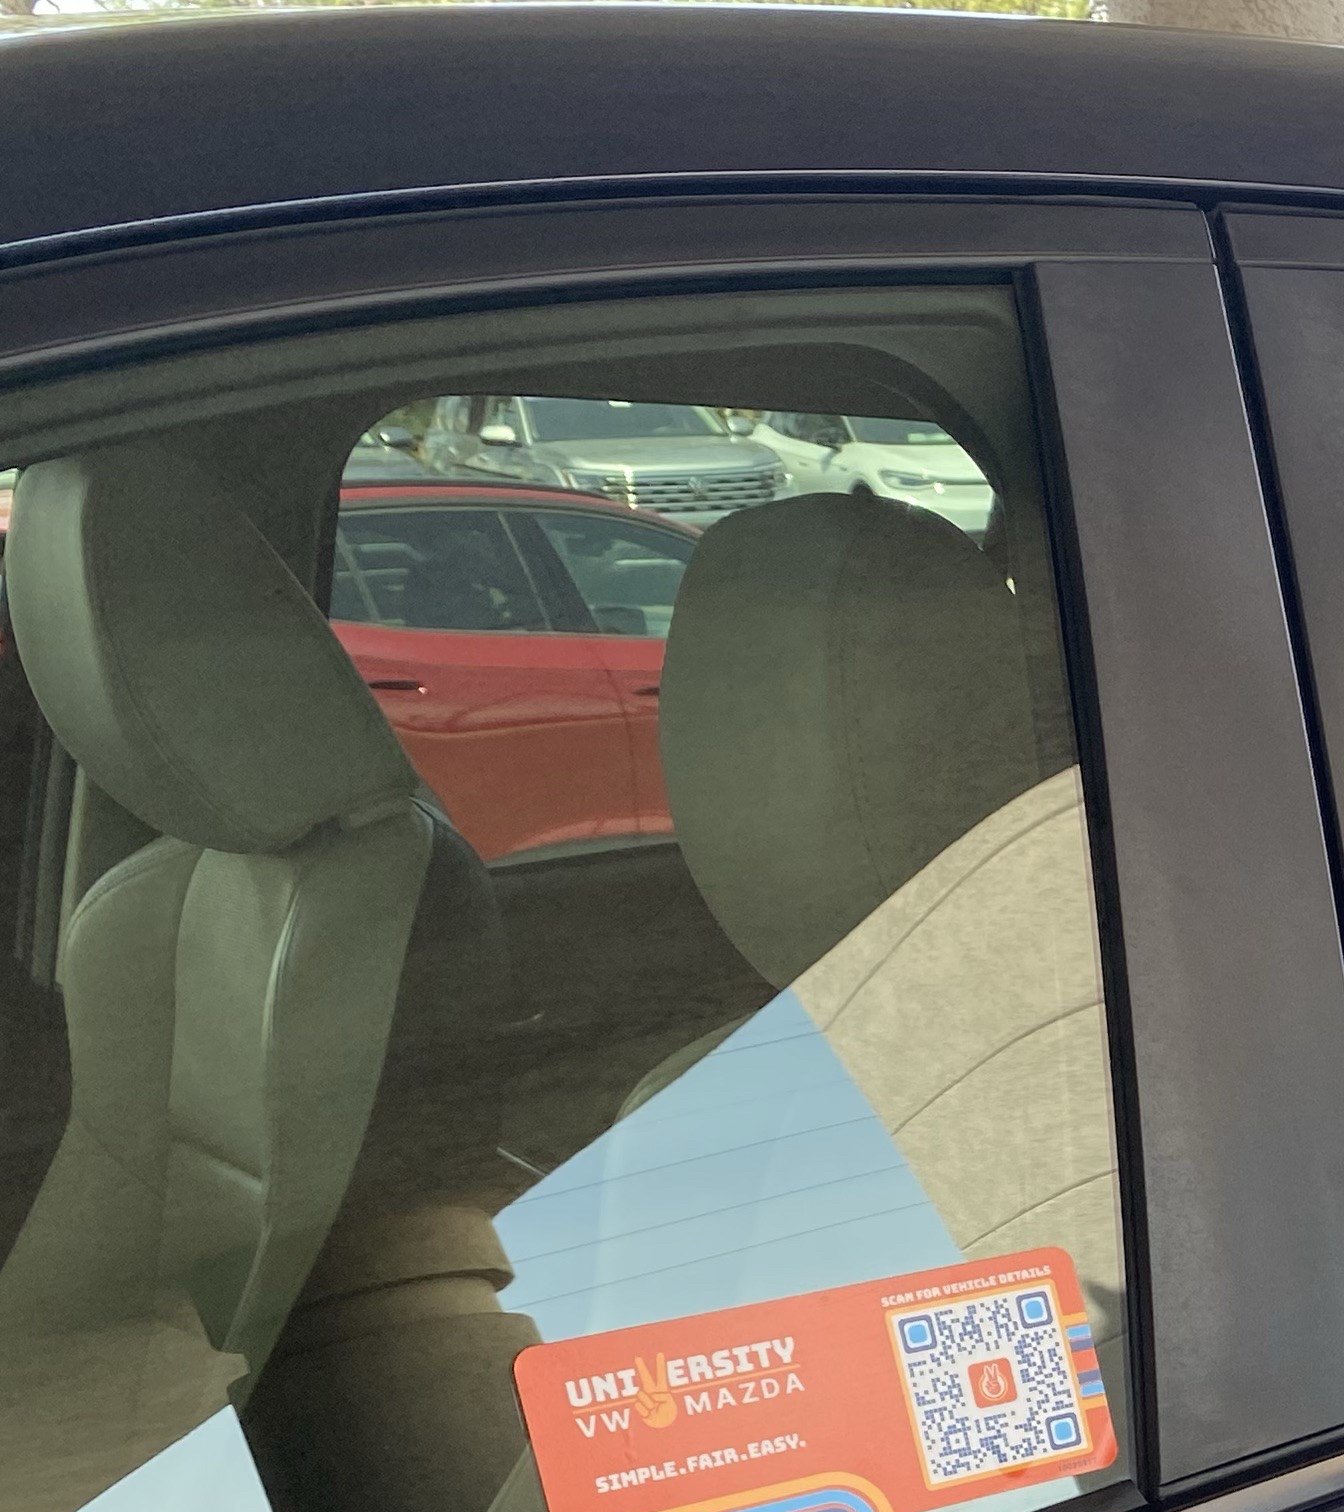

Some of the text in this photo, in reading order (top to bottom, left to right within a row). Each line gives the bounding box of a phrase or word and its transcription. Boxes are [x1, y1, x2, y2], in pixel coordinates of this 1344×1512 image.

[879, 1264, 1052, 1308] SCAN FOR VEHICLE DETAILS
[563, 1335, 798, 1408] UNIVERSITY
[574, 1371, 805, 1439] VW MAZDA
[593, 1430, 807, 1494] SIMPLE.FAIR.EASY.
